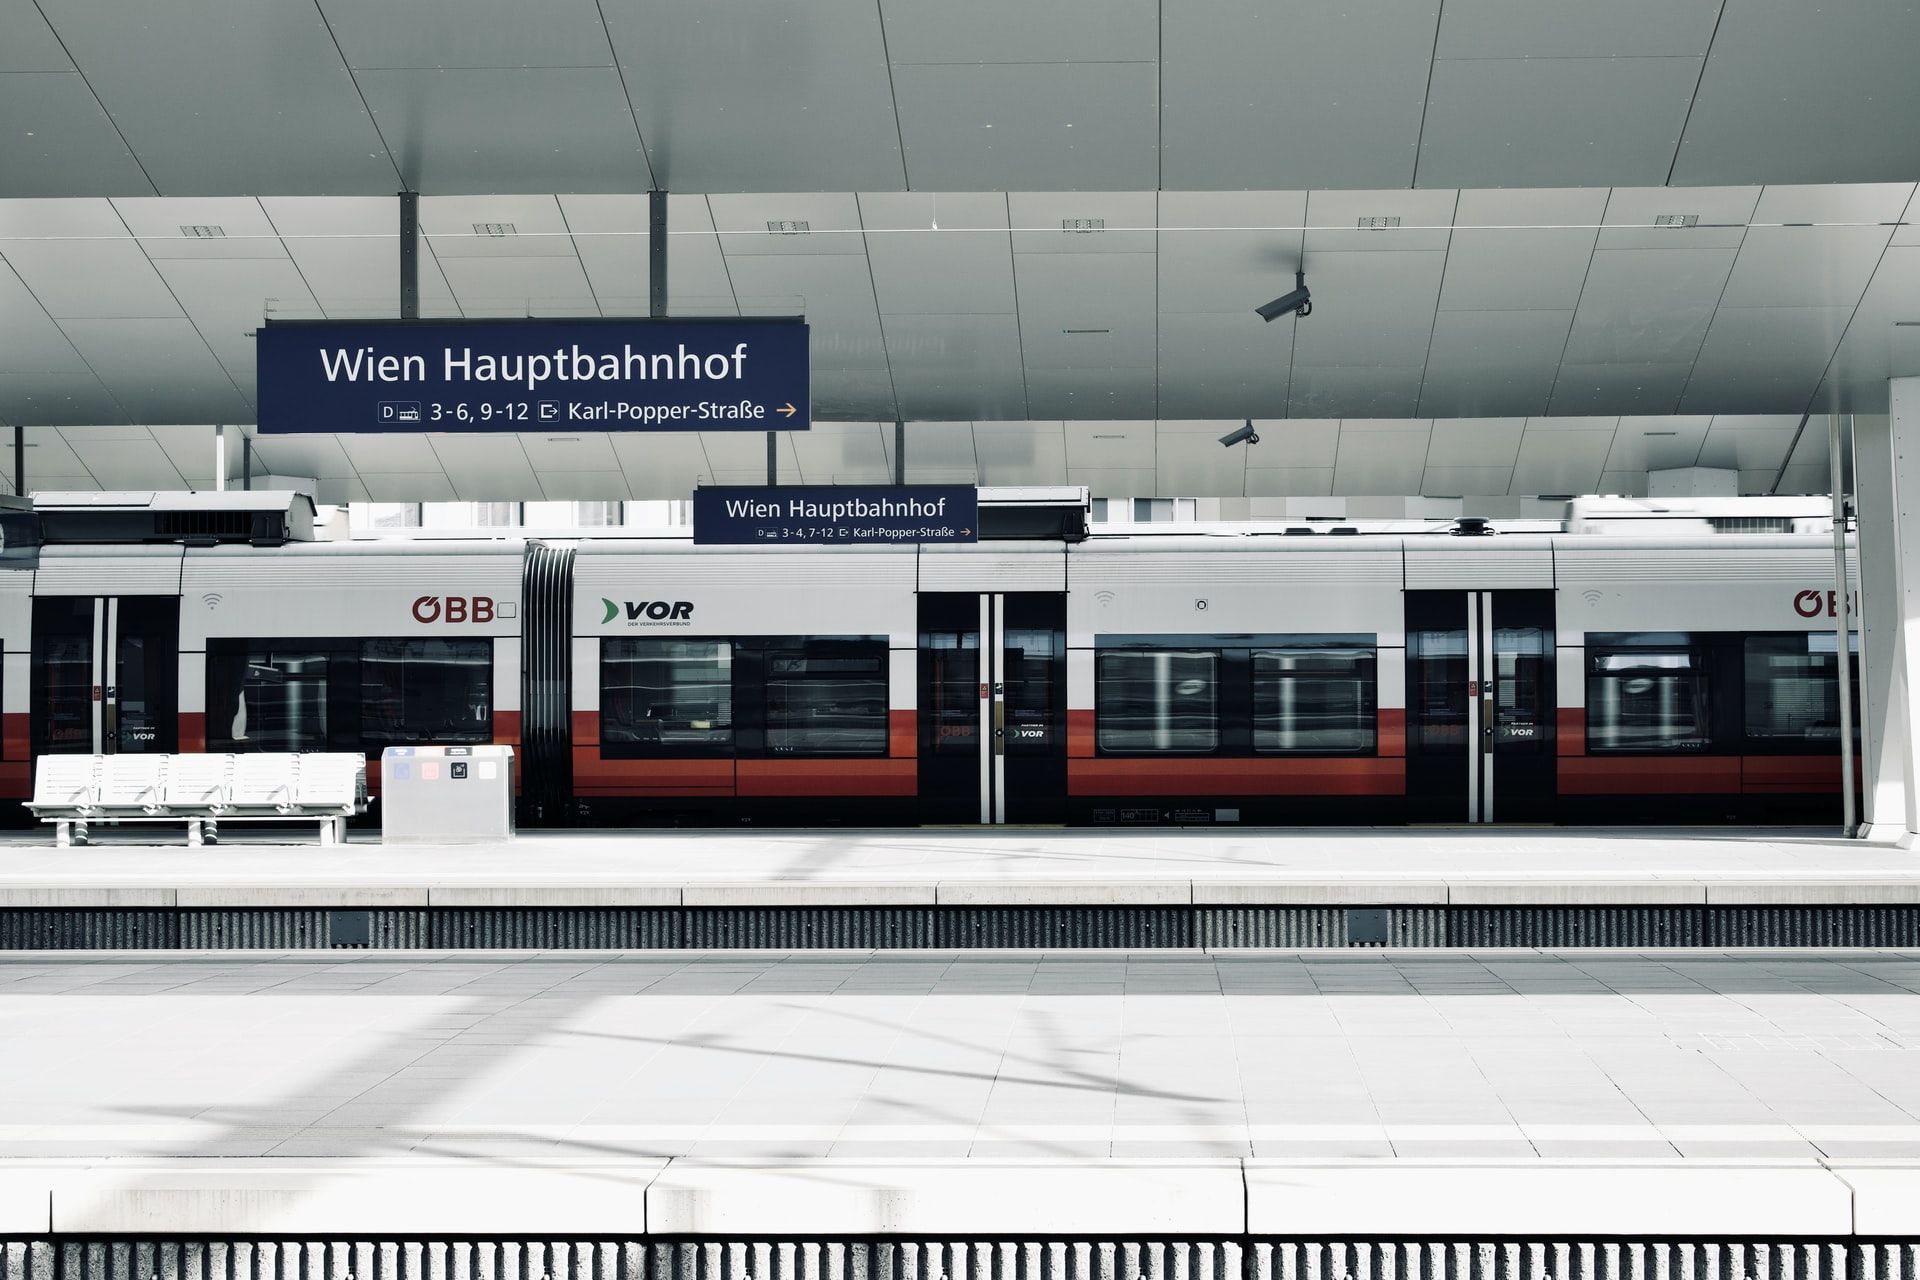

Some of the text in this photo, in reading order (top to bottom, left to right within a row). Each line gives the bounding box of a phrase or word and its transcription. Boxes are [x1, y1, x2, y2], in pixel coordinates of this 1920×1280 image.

[320, 347, 426, 382] Wien
[444, 343, 747, 390] Hauptbahnhof
[383, 399, 765, 425] D 3-6, 9-12 Karl-Popper-Straße
[726, 498, 945, 522] Wien Hauptbahnhof
[758, 529, 764, 537] D
[809, 528, 833, 538] 7-12
[853, 526, 955, 541] Karl-Popper-Straße
[412, 595, 494, 624] ÖBB
[624, 601, 694, 620] VOR
[1793, 590, 1858, 618] ÖB
[1021, 730, 1044, 738] VOR
[1122, 811, 1135, 820] 140
